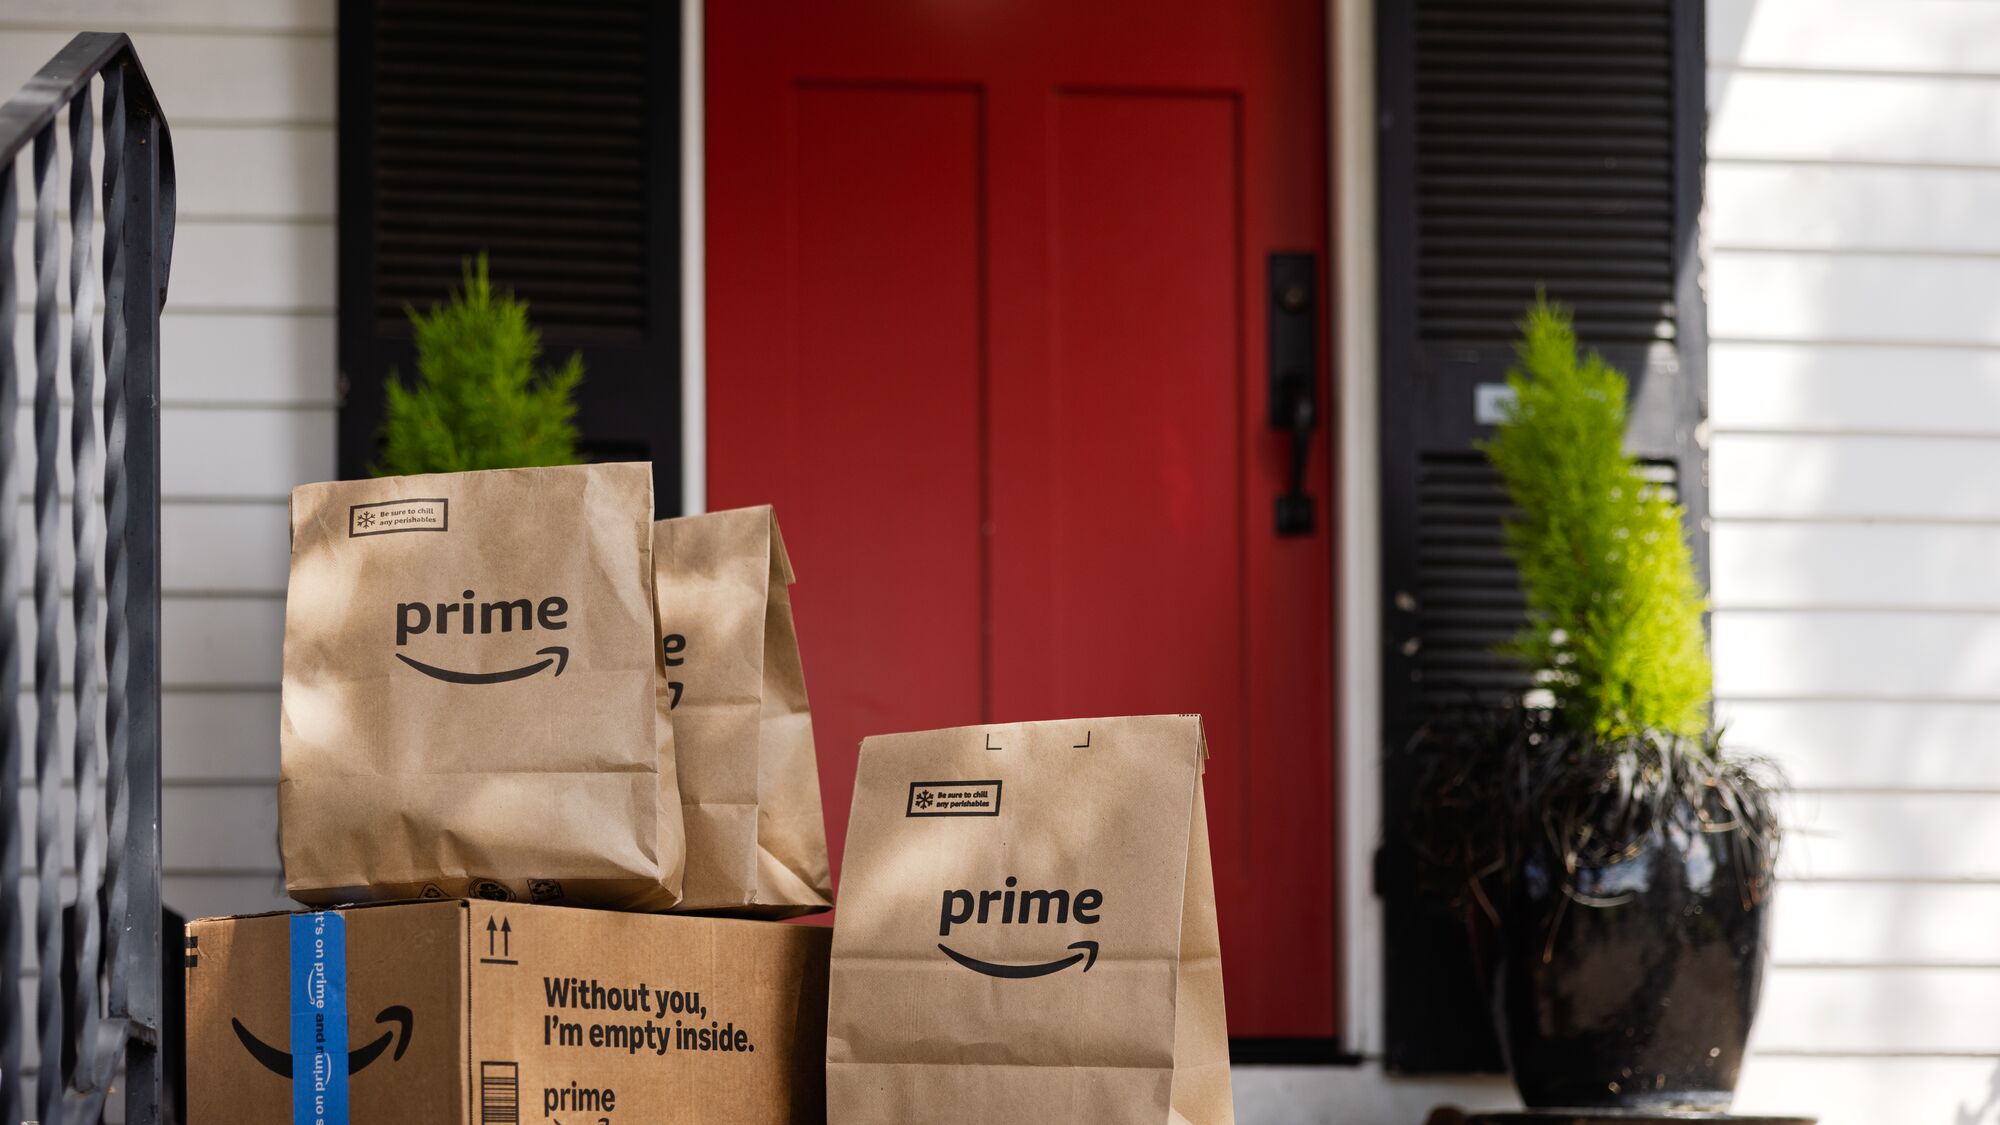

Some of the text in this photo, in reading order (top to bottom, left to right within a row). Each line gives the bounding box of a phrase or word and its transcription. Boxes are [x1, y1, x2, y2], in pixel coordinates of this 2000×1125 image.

[379, 510, 389, 518] Be
[417, 507, 434, 515] chill
[379, 516, 437, 527] any perishables
[396, 589, 569, 645] prime
[936, 799, 990, 809] any perishables
[937, 791, 947, 799] Be
[964, 791, 972, 799] to
[972, 790, 989, 798] chill
[939, 876, 1104, 936] prime
[315, 939, 324, 958] on
[314, 962, 327, 1008] prime
[544, 977, 707, 1020] Without you,
[316, 1013, 327, 1043] and
[545, 1015, 755, 1055] I'm empty inside.
[313, 1053, 326, 1091] prim
[315, 1095, 324, 1115] on
[544, 1080, 616, 1117] prime
